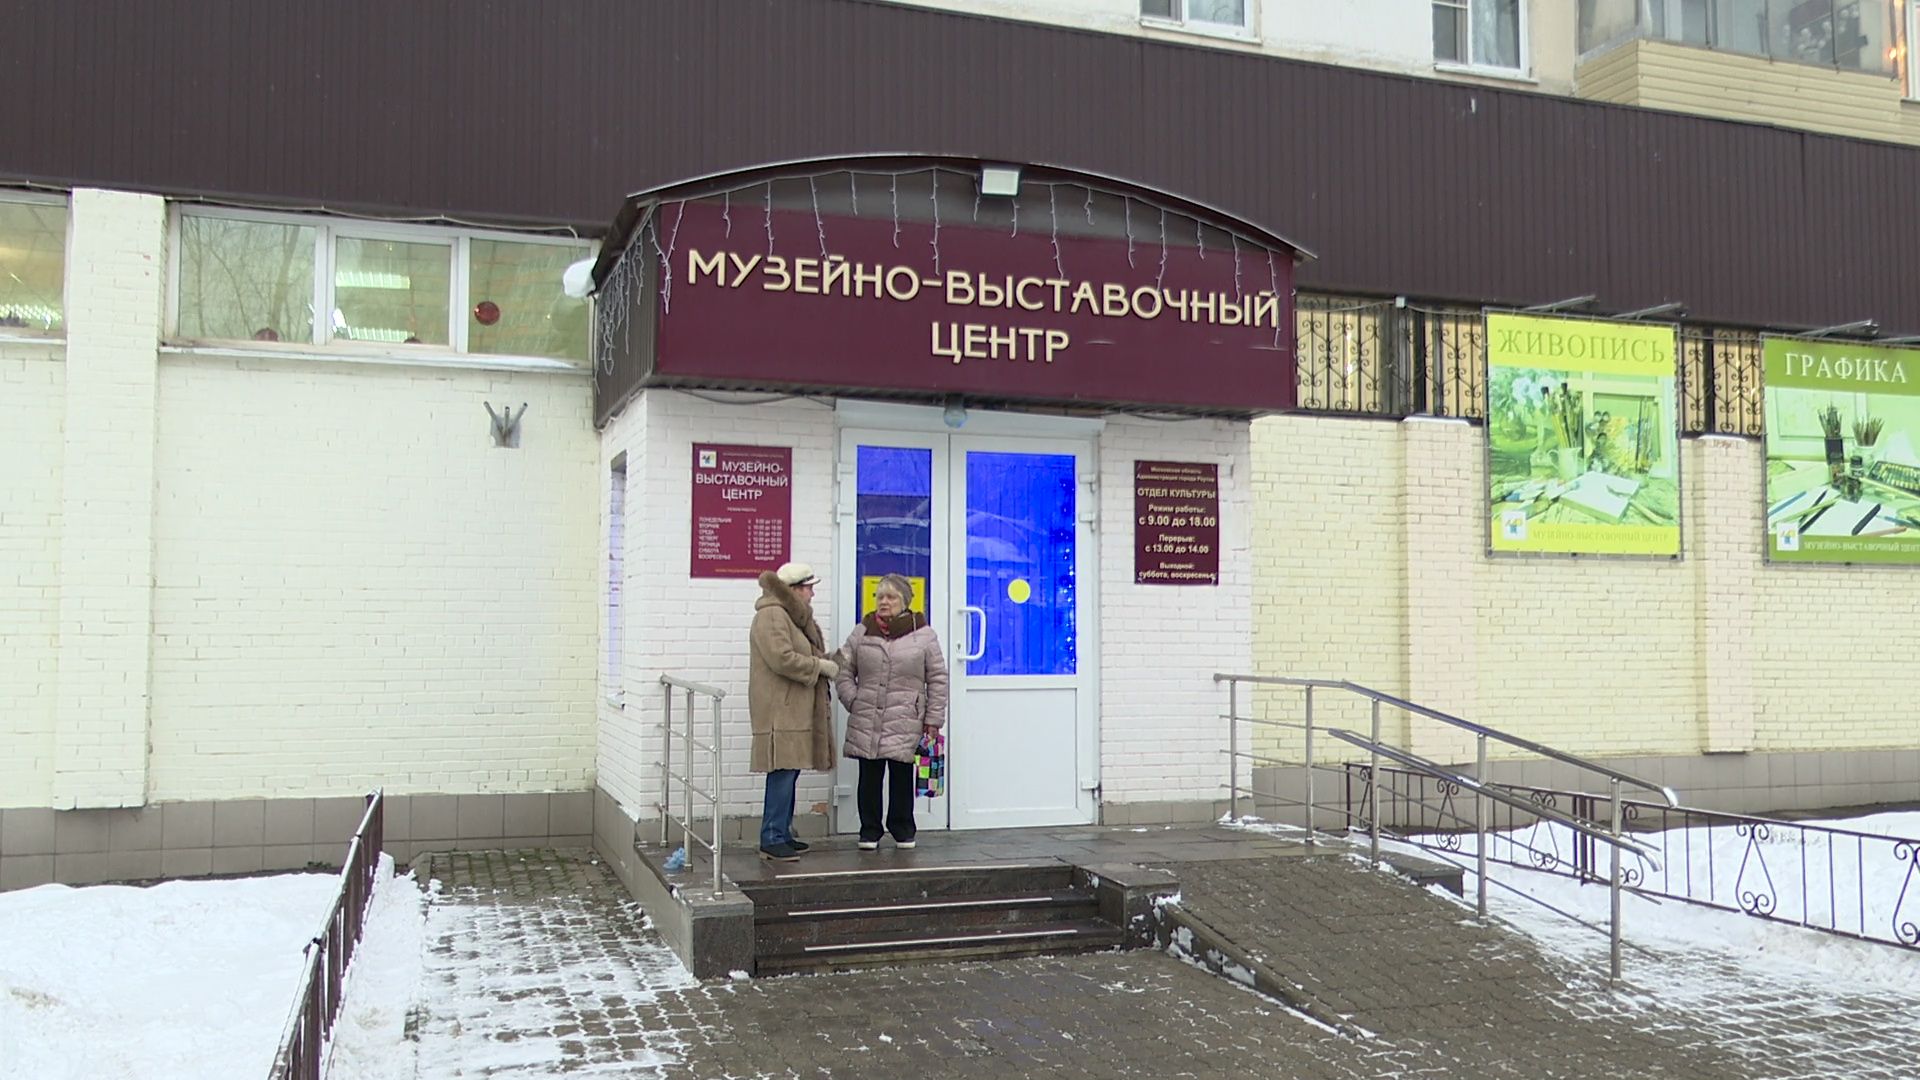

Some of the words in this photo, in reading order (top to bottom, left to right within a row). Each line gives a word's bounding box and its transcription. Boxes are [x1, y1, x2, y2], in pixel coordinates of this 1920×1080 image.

[687, 249, 1279, 328] МУЗЕЙНО-ВЫСТАВОЧНЫЙ
[931, 321, 1070, 363] ЦЕНТР
[1498, 329, 1665, 363] ЖИВОПИСЬ
[1784, 352, 1907, 383] ГРАФИКА
[722, 461, 784, 473] МУЗЕЙНО-
[696, 473, 788, 487] ВЫСТАВОЧНЫЙ
[722, 489, 763, 501] ЦЕНТР
[1137, 488, 1168, 498] ОТДЕЛ
[1169, 489, 1216, 499] КУЛЬТУРЫ
[1148, 504, 1173, 512] Режим
[1174, 505, 1206, 514] работы:
[1138, 517, 1145, 525] с
[1147, 515, 1170, 526] 9.00
[1171, 518, 1186, 527] до
[1188, 516, 1216, 527] 18.00
[1159, 534, 1195, 543] Перерыв:
[1152, 544, 1174, 553] 13.00
[1188, 545, 1209, 554] 14.00
[1159, 562, 1194, 571] Выходной:
[1139, 570, 1170, 579] суббота,
